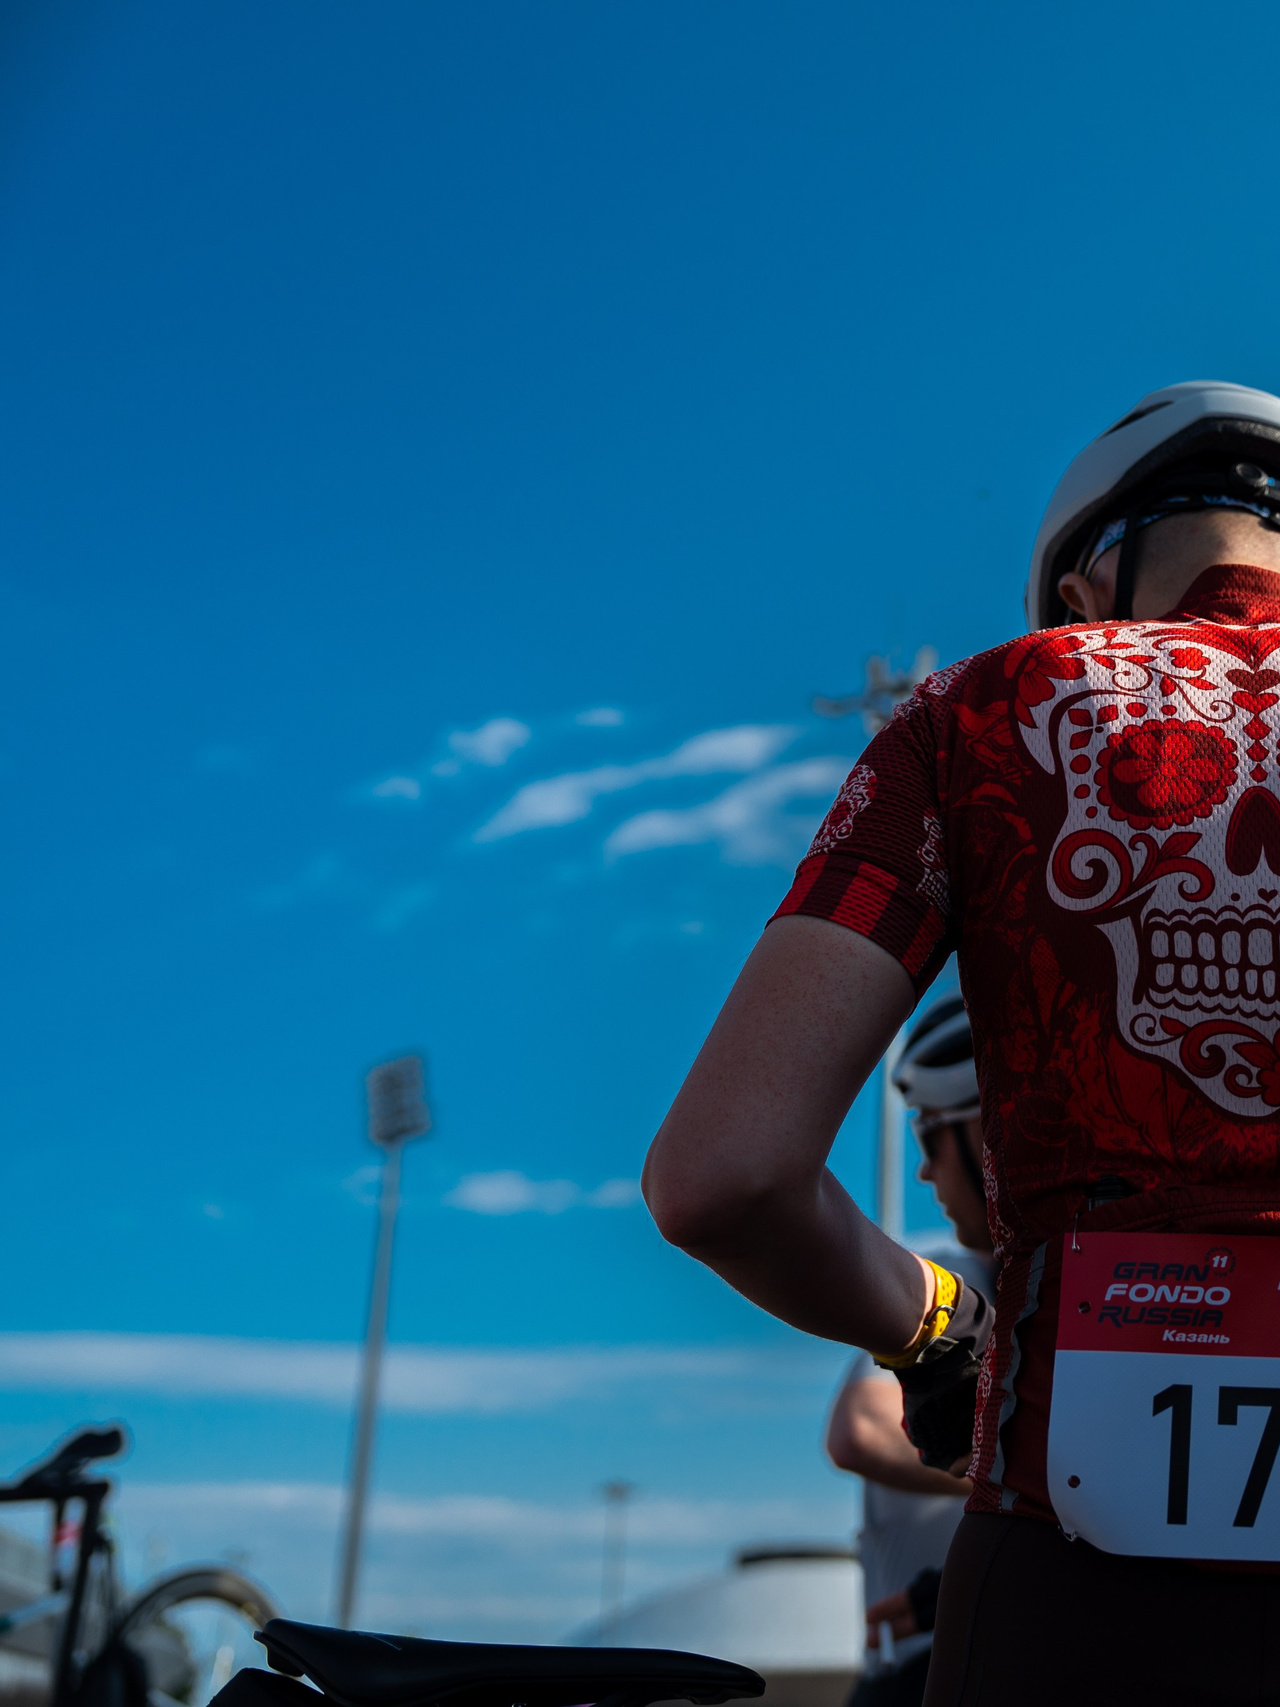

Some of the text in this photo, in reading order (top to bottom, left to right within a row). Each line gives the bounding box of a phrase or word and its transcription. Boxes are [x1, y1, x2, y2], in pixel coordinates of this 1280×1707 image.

[1113, 1261, 1211, 1283] GRAN
[1212, 1255, 1228, 1268] 11
[1104, 1283, 1231, 1305] FONDO
[1097, 1305, 1224, 1328] RUSSIA
[1162, 1329, 1230, 1344] Казань
